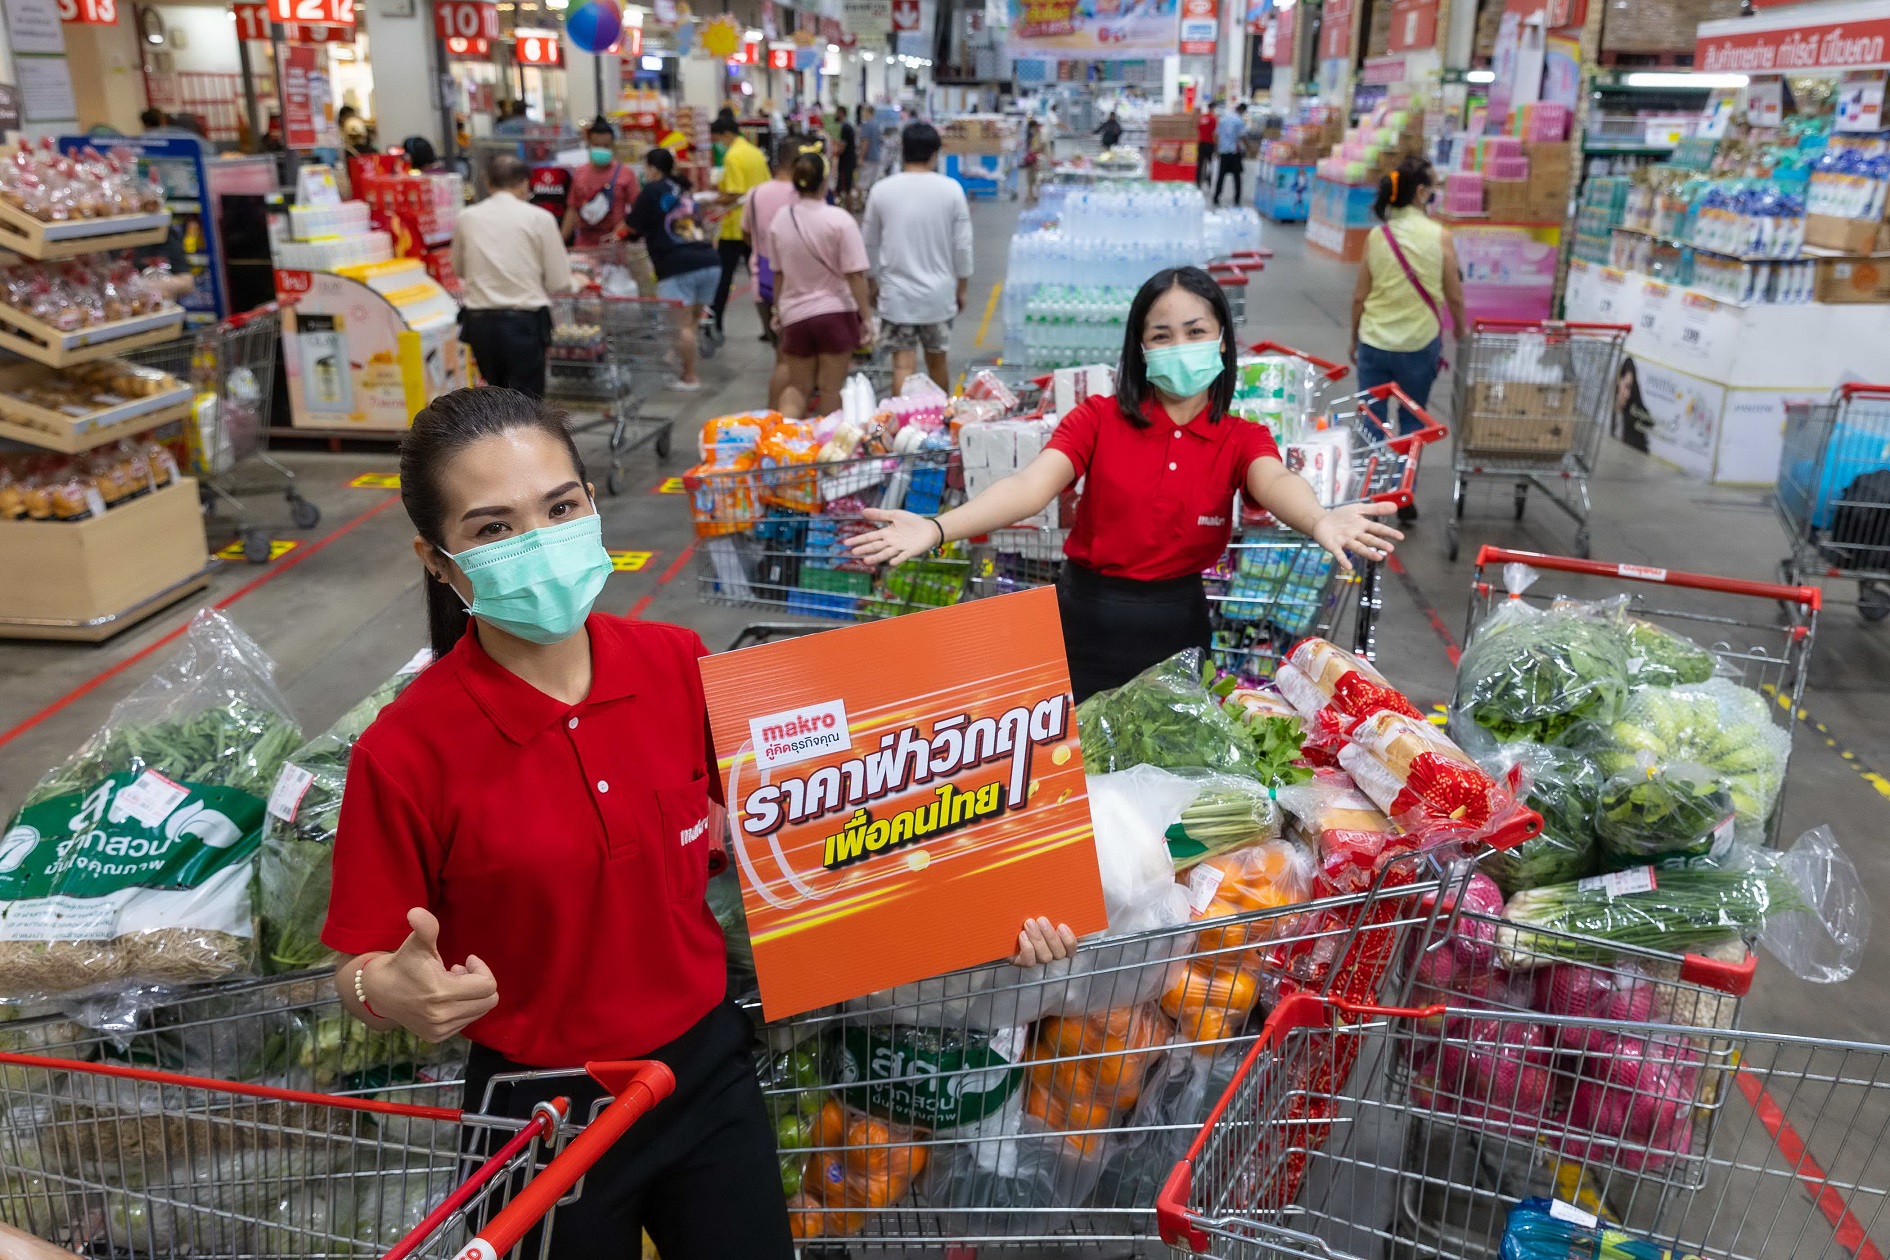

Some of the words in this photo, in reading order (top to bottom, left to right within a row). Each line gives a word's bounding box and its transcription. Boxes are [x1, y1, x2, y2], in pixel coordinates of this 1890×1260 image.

[439, 4, 480, 37] 10
[762, 712, 836, 743] makro
[765, 732, 840, 761] คู่คิดธุรกิจคุณ
[743, 693, 1067, 837] ราคาฝ่าวิกฤต
[822, 781, 1001, 868] เพื่อคนไทย
[56, 829, 172, 859] จากสวน
